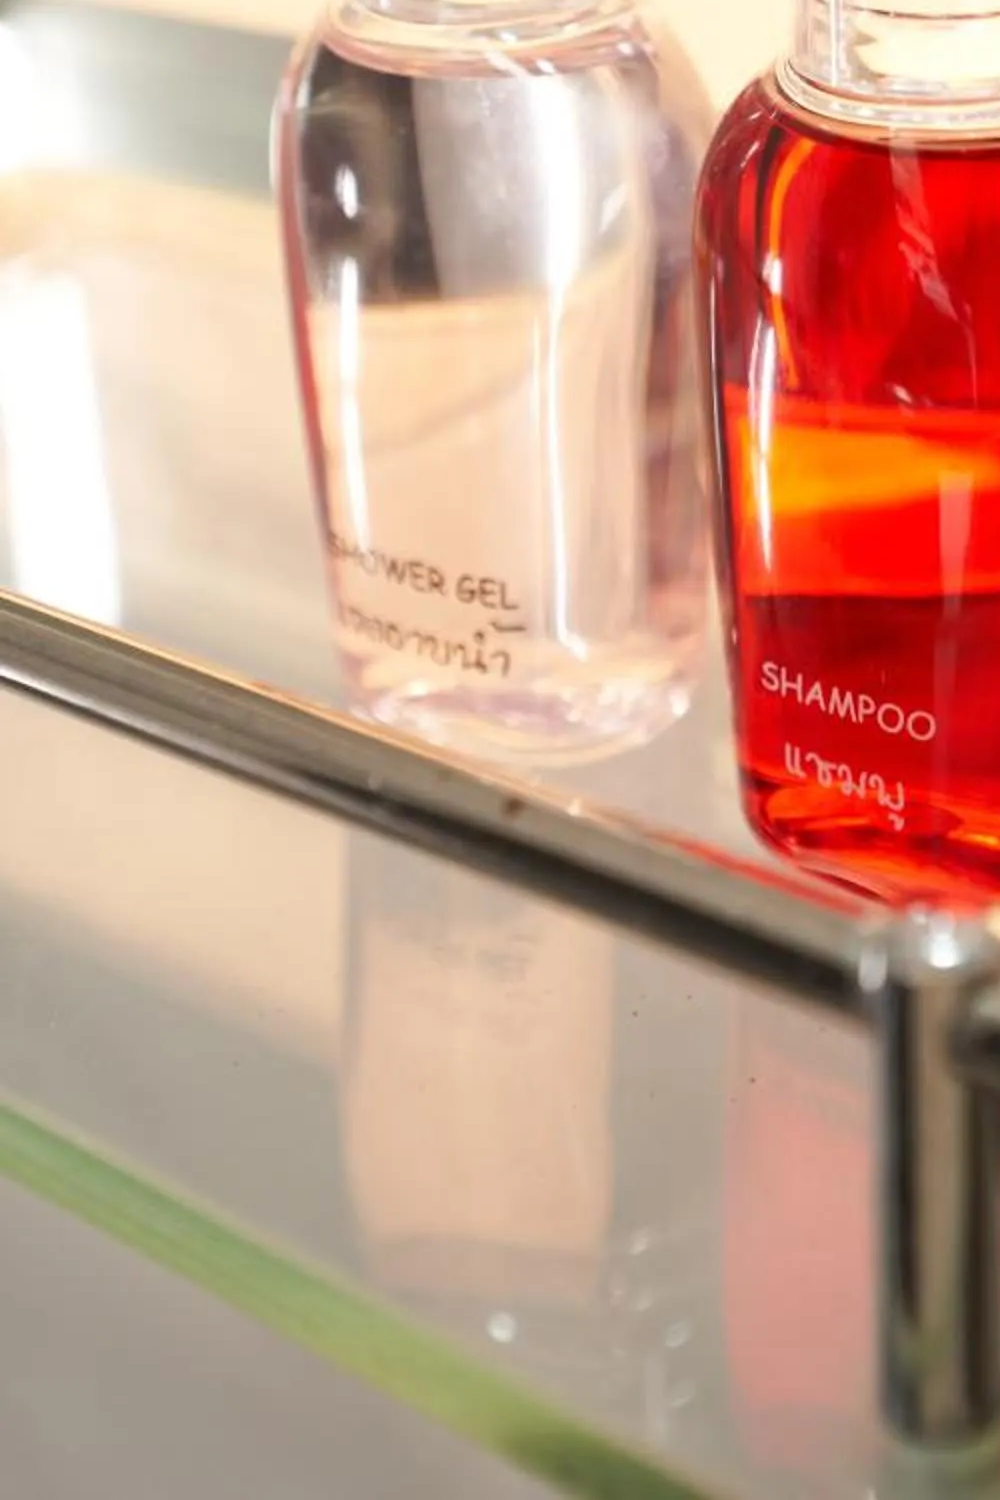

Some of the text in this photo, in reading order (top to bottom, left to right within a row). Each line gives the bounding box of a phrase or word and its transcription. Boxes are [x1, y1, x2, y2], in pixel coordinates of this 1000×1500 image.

[455, 573, 520, 611] GEL
[761, 660, 937, 741] SHAMPOO
[784, 741, 906, 831] แชมพู
